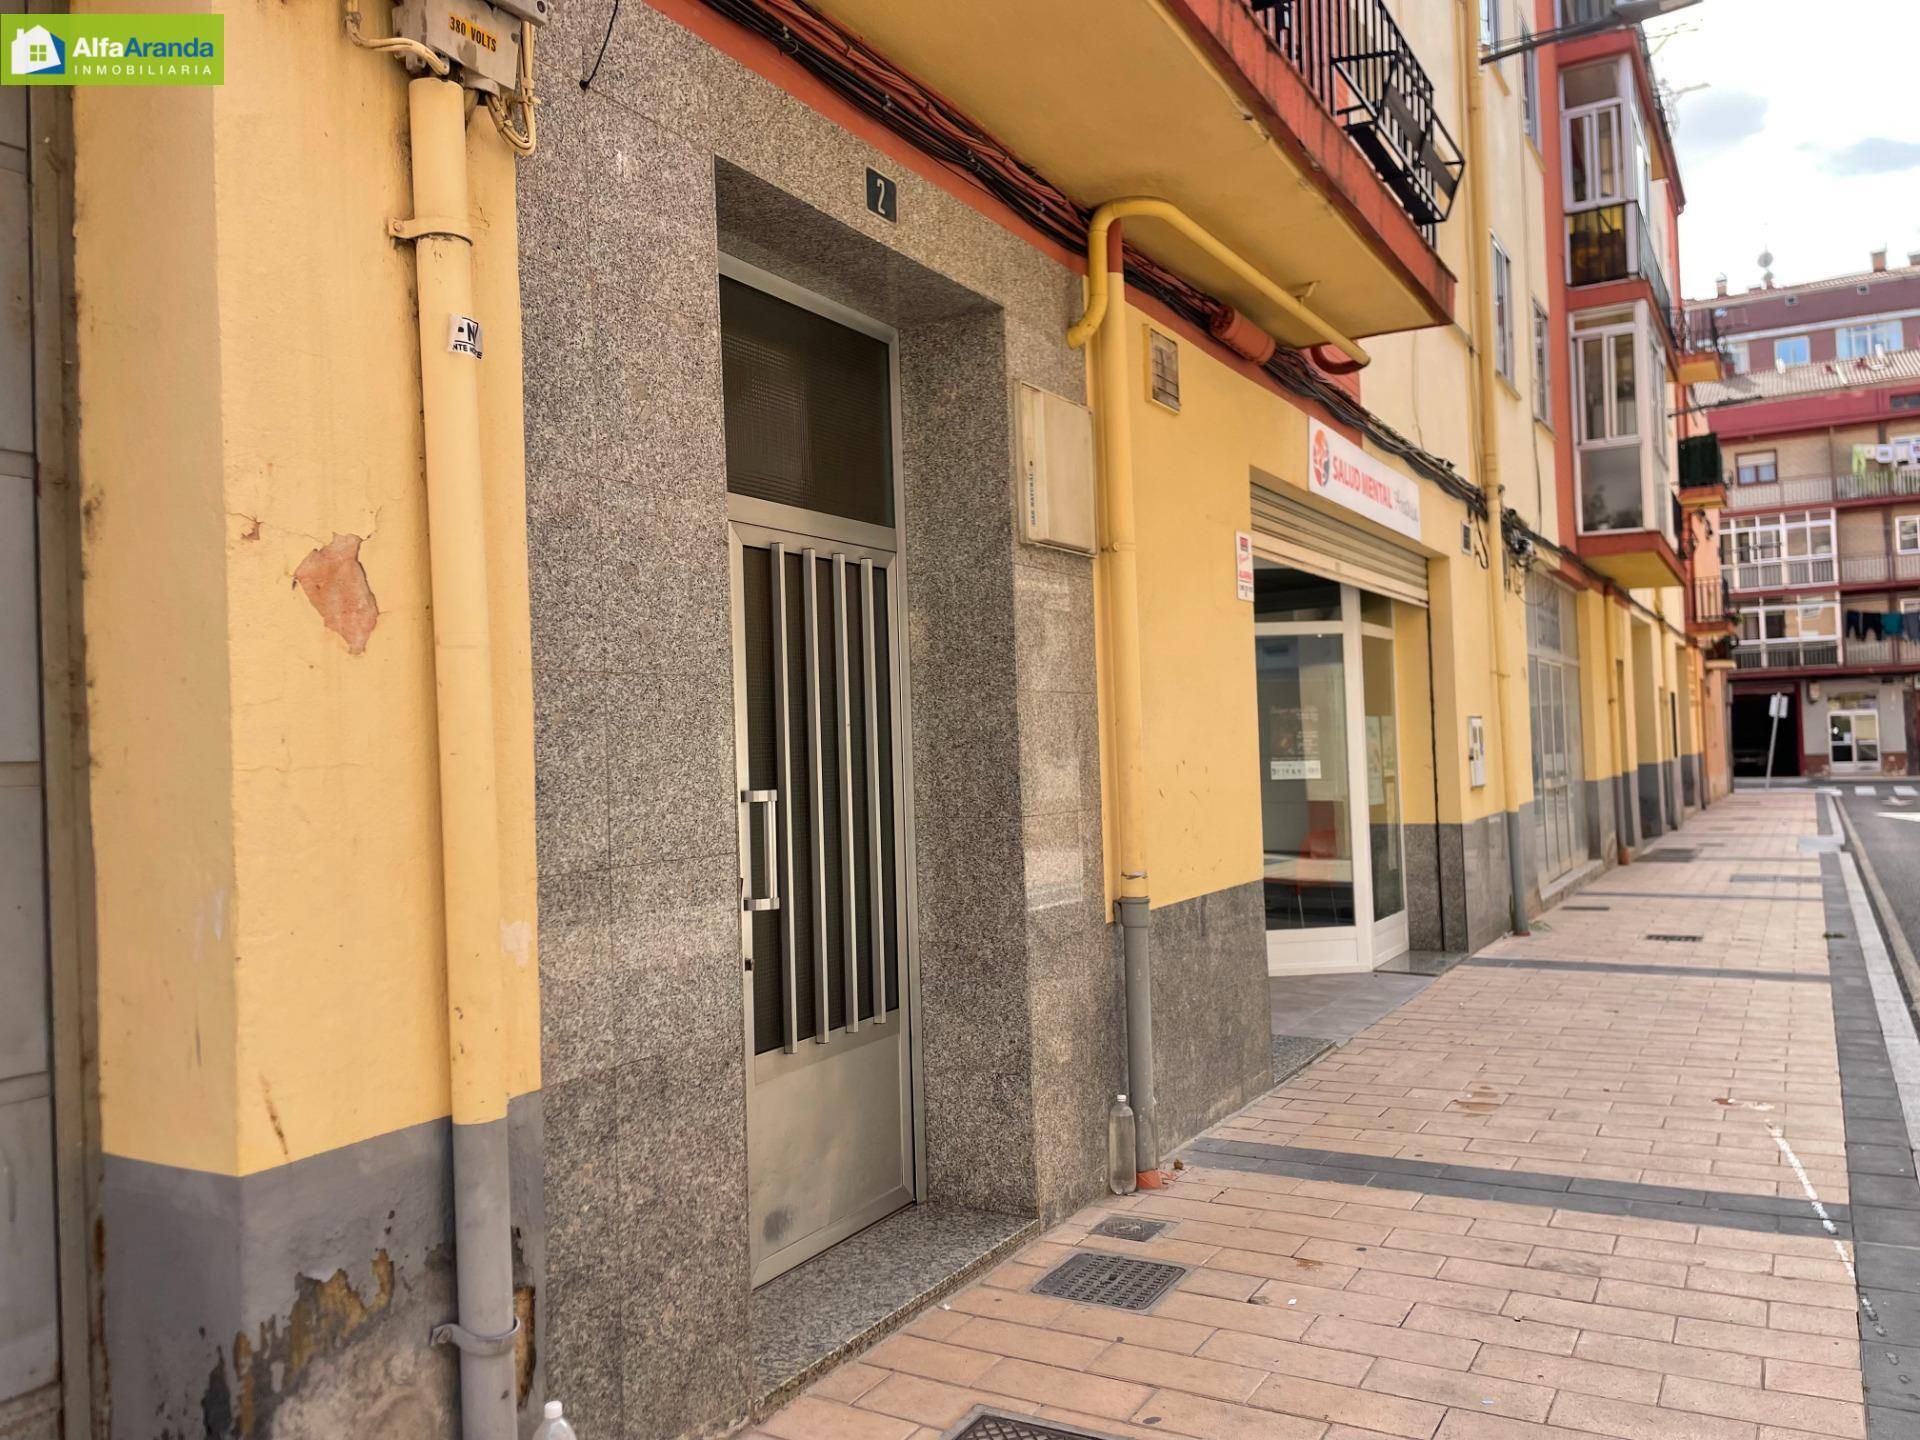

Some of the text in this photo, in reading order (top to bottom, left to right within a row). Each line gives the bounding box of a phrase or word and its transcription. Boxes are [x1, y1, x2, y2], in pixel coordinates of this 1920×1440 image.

[449, 16, 497, 53] 380 VOLTS
[876, 178, 886, 215] 2
[1332, 455, 1361, 492] SALUD
[1361, 471, 1393, 509] MENTAL
